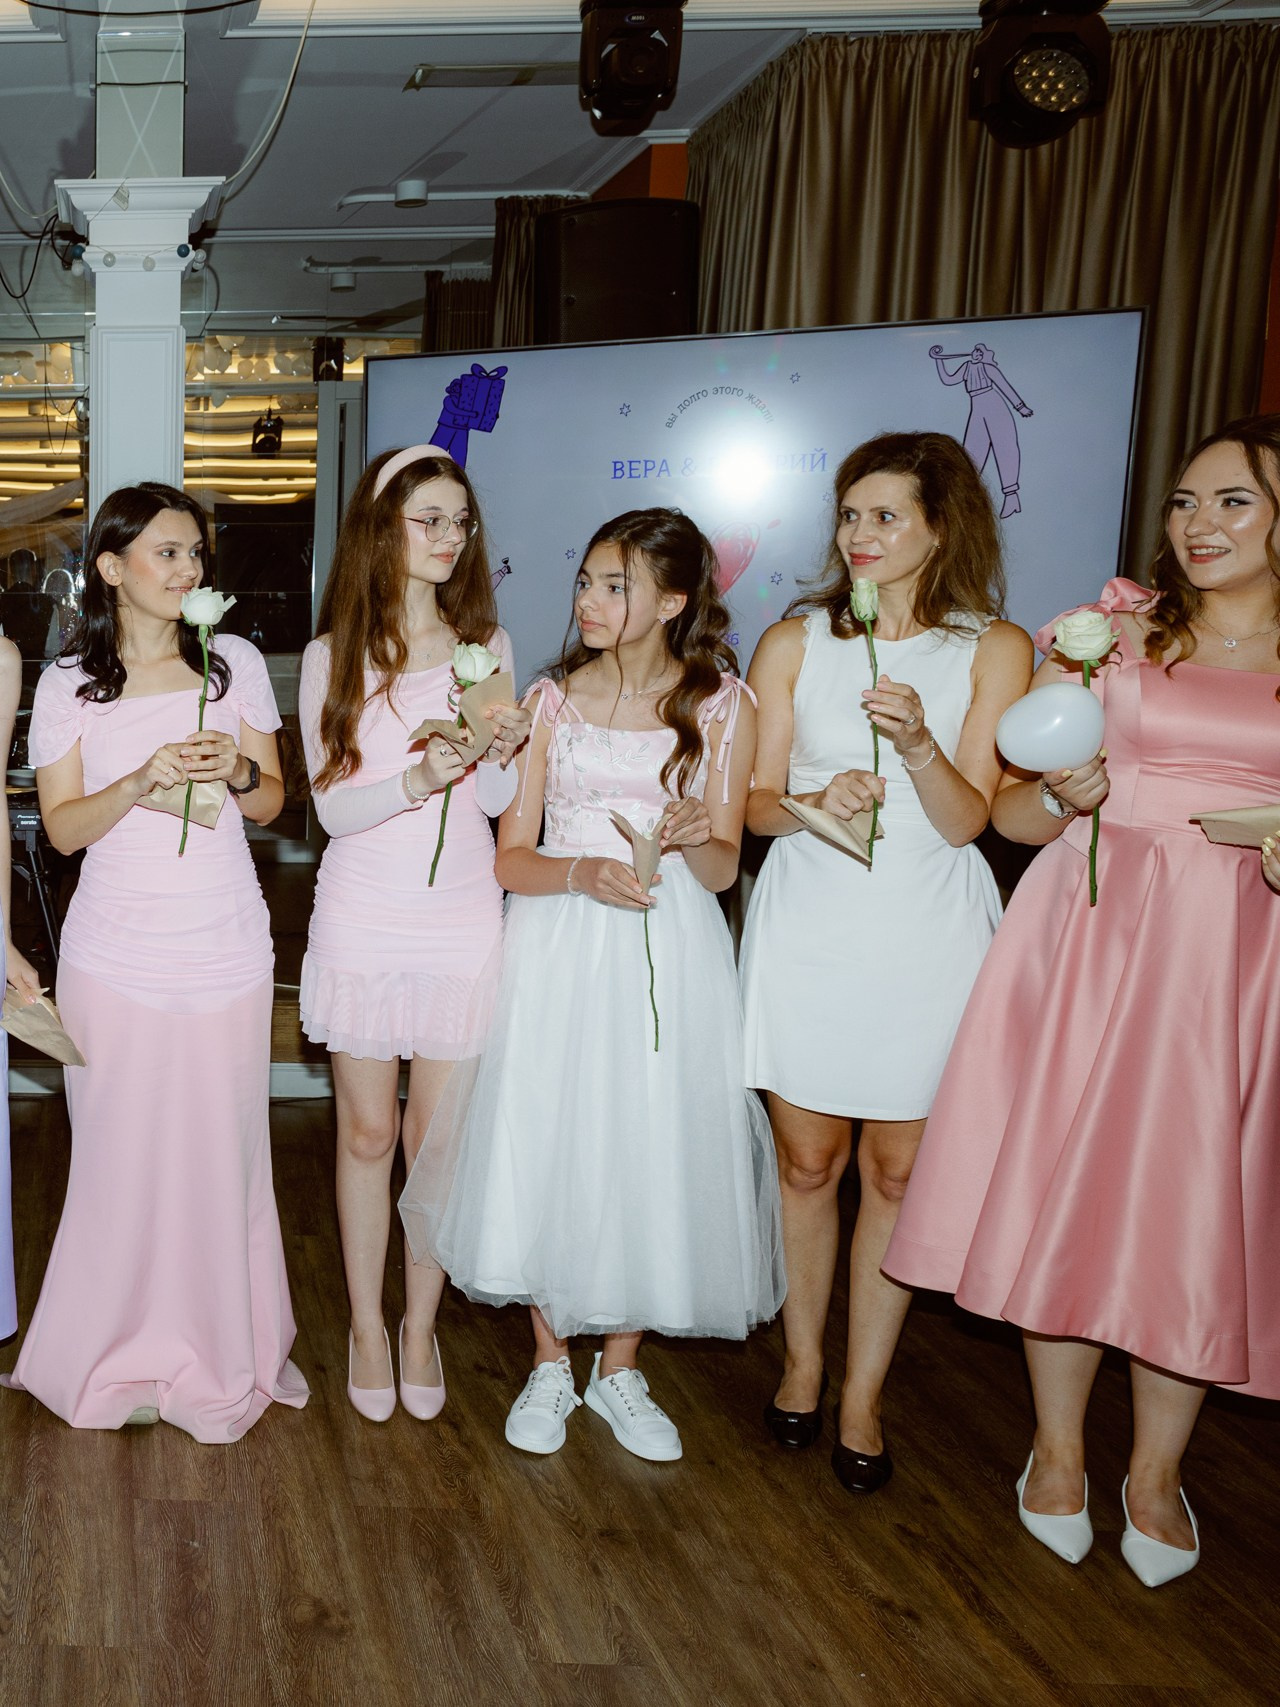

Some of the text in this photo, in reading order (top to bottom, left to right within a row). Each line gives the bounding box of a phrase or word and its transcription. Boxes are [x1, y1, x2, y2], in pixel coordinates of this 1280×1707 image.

[665, 413, 678, 429] вы
[677, 389, 709, 415] долго
[712, 386, 744, 397] этого
[611, 459, 672, 479] ВЕРА
[681, 457, 697, 477] &
